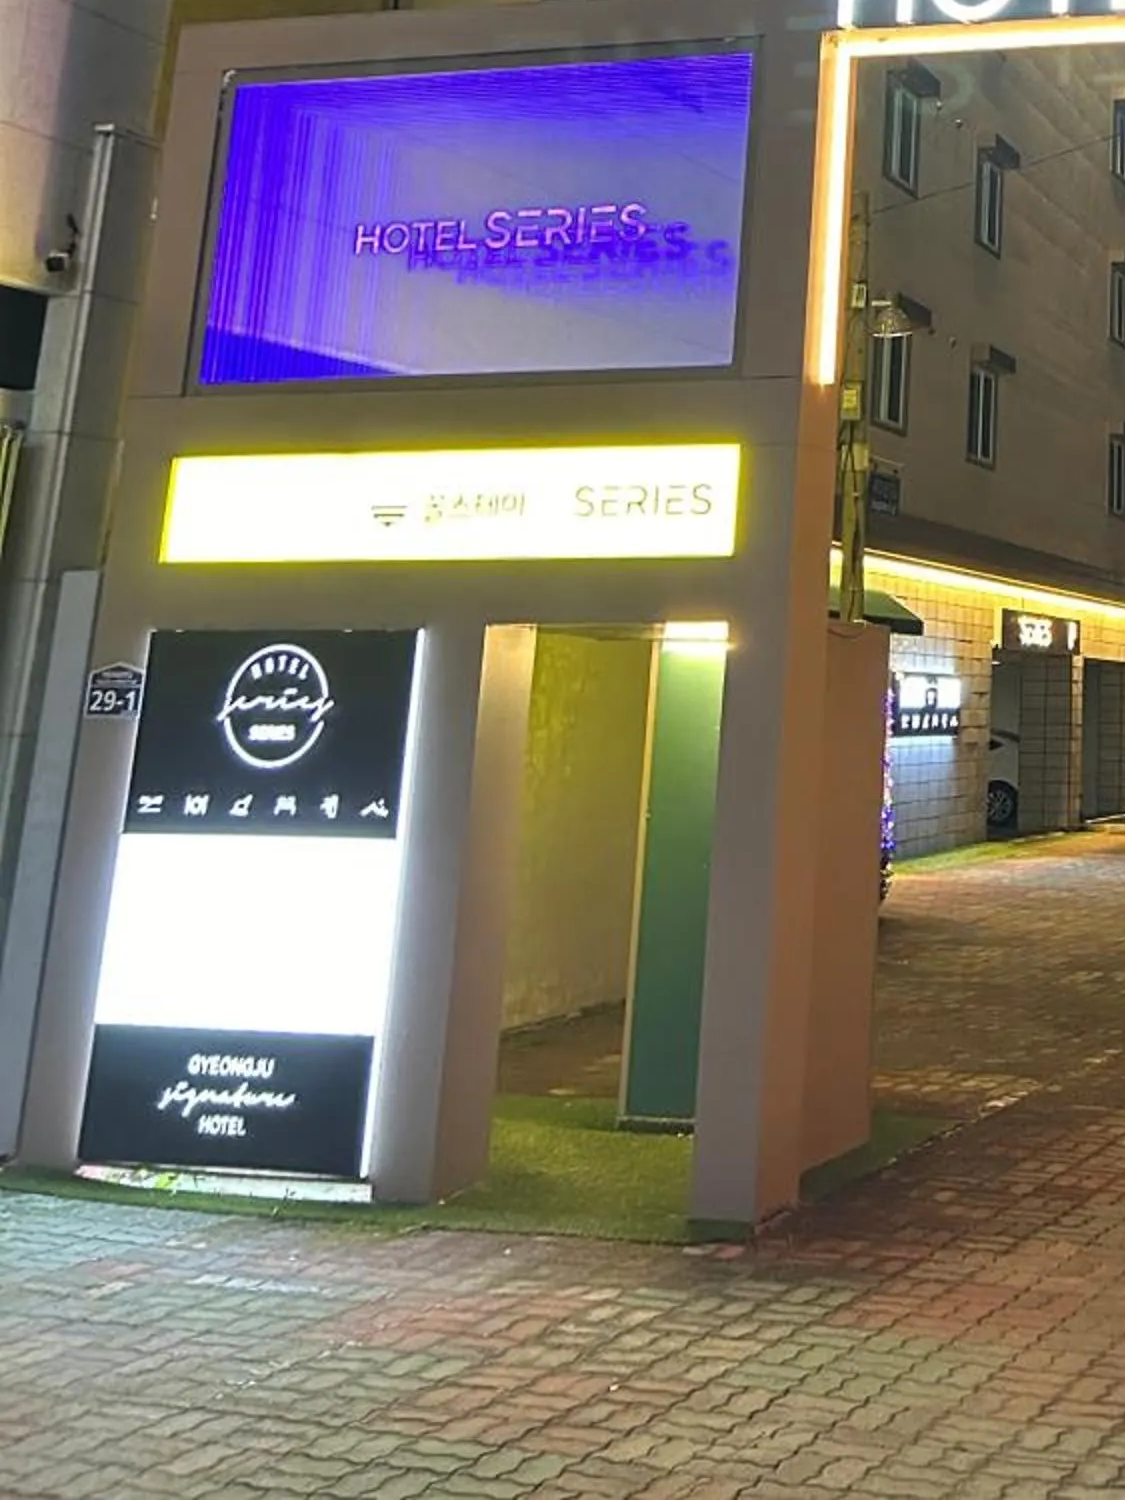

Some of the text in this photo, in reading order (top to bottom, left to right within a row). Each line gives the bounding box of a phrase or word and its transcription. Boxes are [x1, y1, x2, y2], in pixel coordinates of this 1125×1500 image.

[354, 202, 649, 255] HOTEL SERIES
[575, 483, 713, 517] SERIES
[250, 654, 311, 680] HOTEL
[90, 690, 137, 712] 29-1
[187, 1053, 275, 1078] GYEONGJU
[198, 1114, 246, 1136] HOTEL
